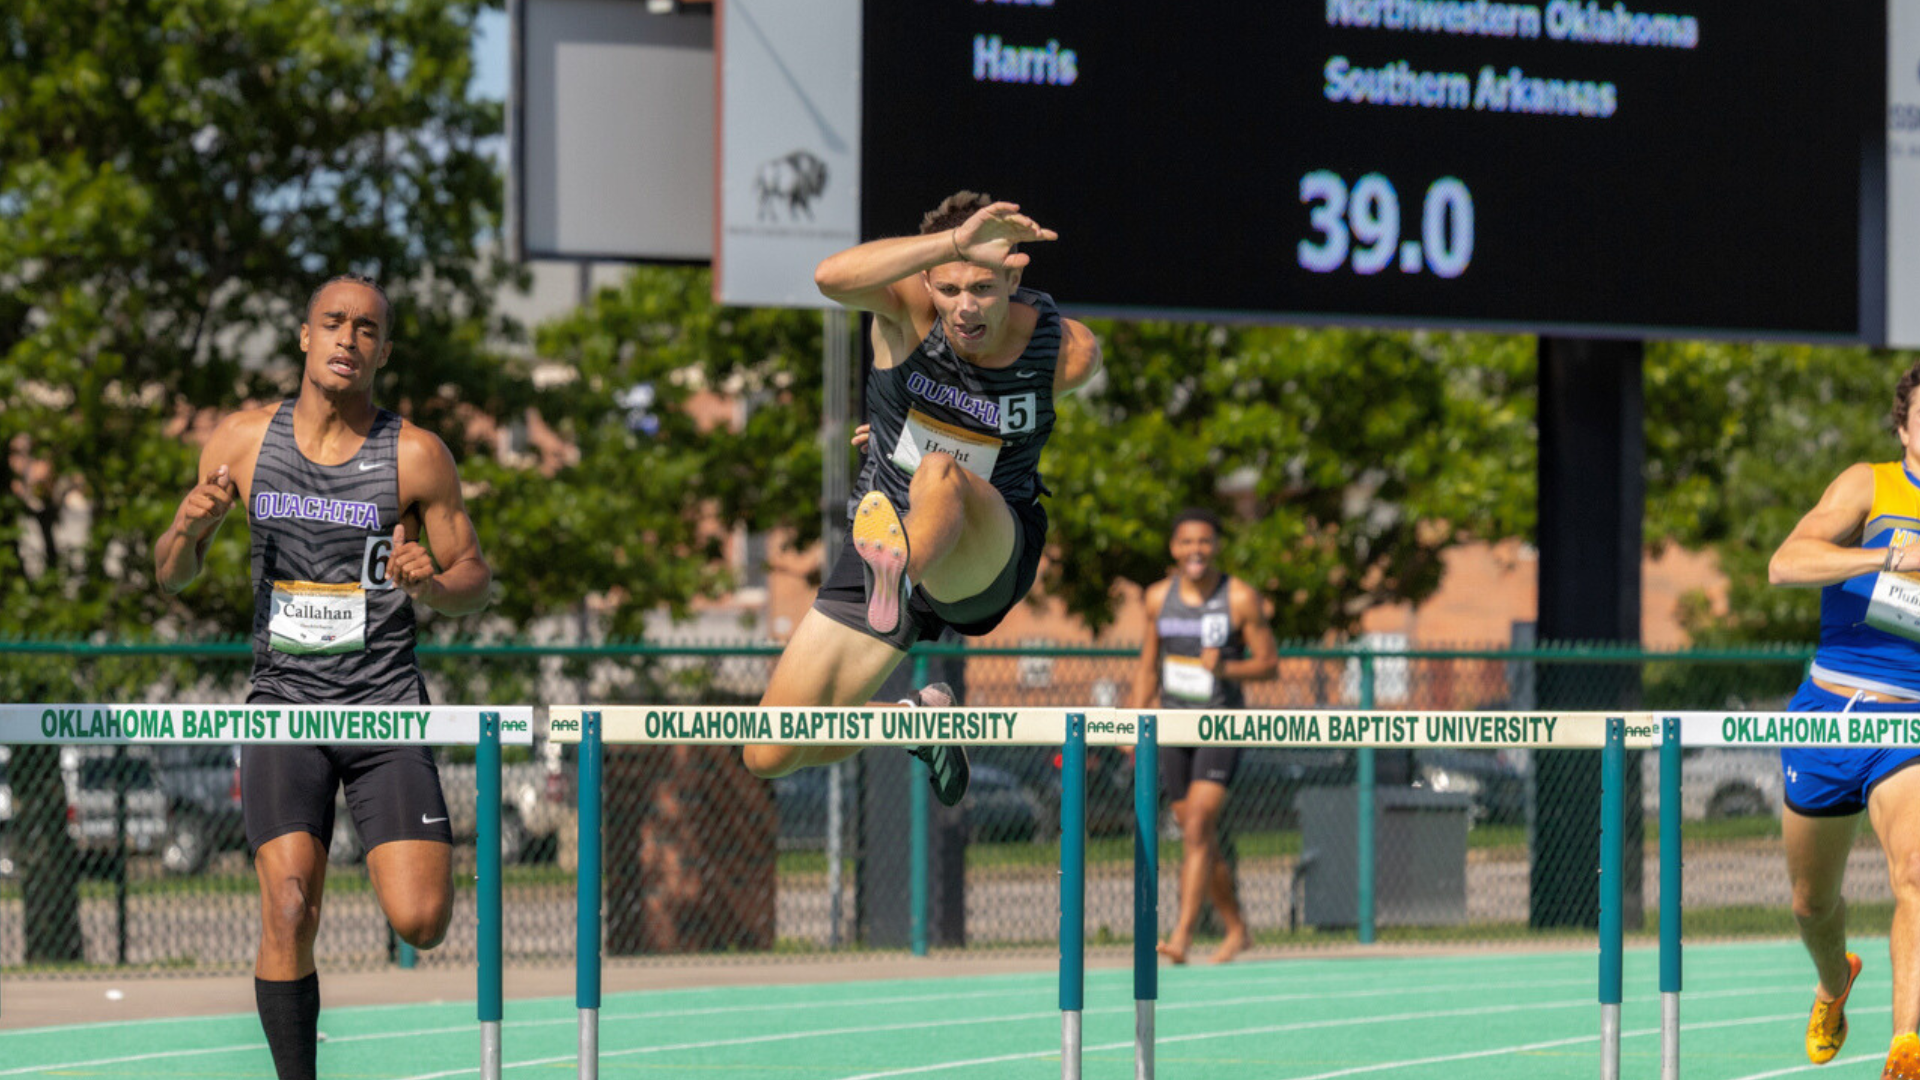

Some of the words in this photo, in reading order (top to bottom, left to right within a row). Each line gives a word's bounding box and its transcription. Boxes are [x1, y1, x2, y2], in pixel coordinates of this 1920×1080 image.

[1545, 0, 1699, 48] Oklahoma
[973, 34, 1079, 86] Harris
[1323, 55, 1470, 110] Southern
[1472, 65, 1617, 118] Arkansas
[1298, 170, 1475, 278] 39.0
[907, 371, 1001, 427] OUACHI
[1007, 397, 1027, 430] 5
[255, 492, 381, 530] OUACHITA
[368, 540, 391, 585] 6
[283, 603, 352, 620] Callahan
[41, 711, 174, 738] OKLAHOMA
[182, 711, 280, 739] BAPTIST
[289, 711, 430, 740] UNIVERSITY
[645, 712, 771, 739] OKLAHOMA
[781, 712, 874, 739] BAPTIST
[882, 712, 1017, 739] UNIVERSITY
[1199, 715, 1321, 742] OKLAHOMA
[1328, 716, 1419, 742] BAPTIST
[1427, 716, 1557, 743] UNIVERSITY
[1722, 717, 1841, 743] OKLAHOMA
[1849, 718, 1920, 744] BAPTIS
